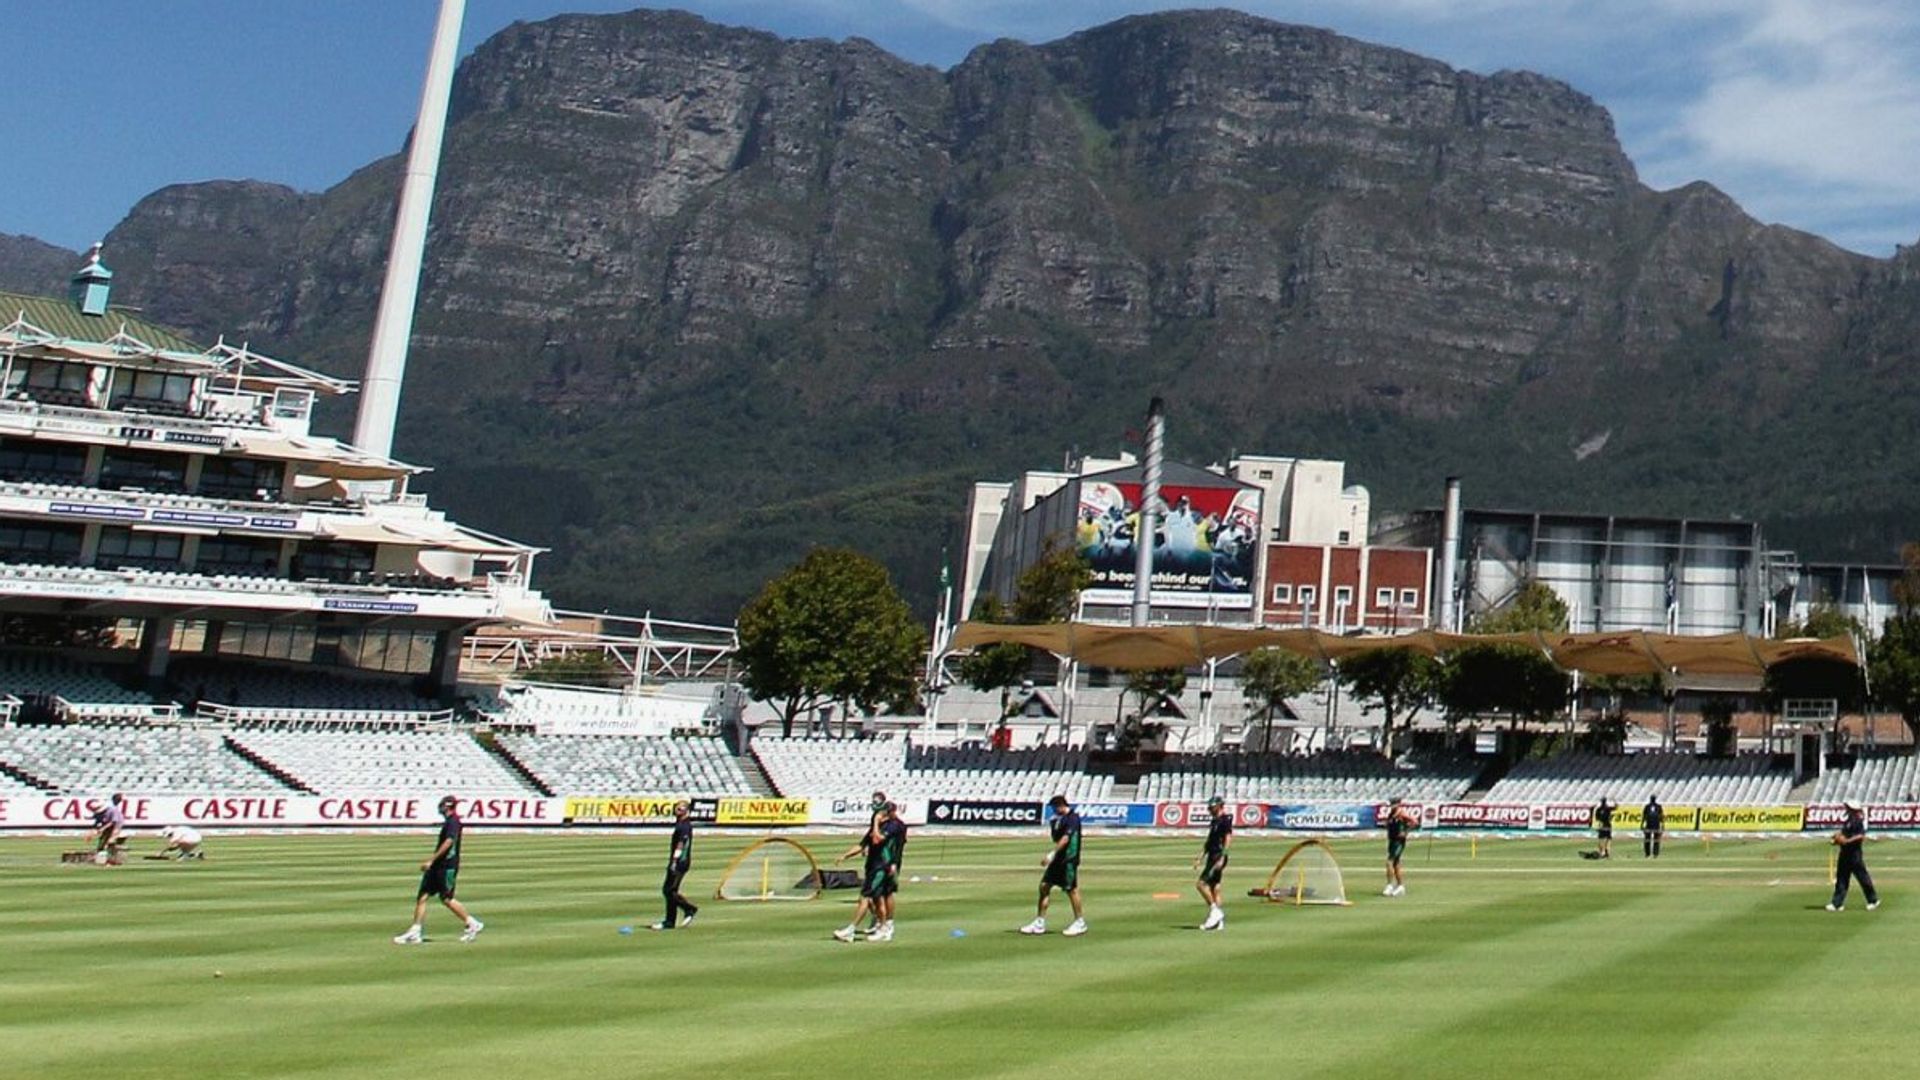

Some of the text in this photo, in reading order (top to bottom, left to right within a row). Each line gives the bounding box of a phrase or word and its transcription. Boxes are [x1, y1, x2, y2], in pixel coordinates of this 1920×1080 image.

[1151, 571, 1186, 584] ehind
[43, 799, 149, 820] CASLE
[183, 798, 288, 819] CASTLE
[318, 798, 419, 819] CASTLE
[571, 802, 677, 817] THE NEW AG
[720, 801, 809, 815] THE NEW AGE
[952, 804, 1037, 821] Investec
[1074, 804, 1129, 818] MECER
[1441, 806, 1529, 821] SERVO SERVO
[1547, 808, 1591, 821] SERVO
[1702, 811, 1801, 825] UltraTech Cement
[1869, 809, 1912, 823] SERVO
